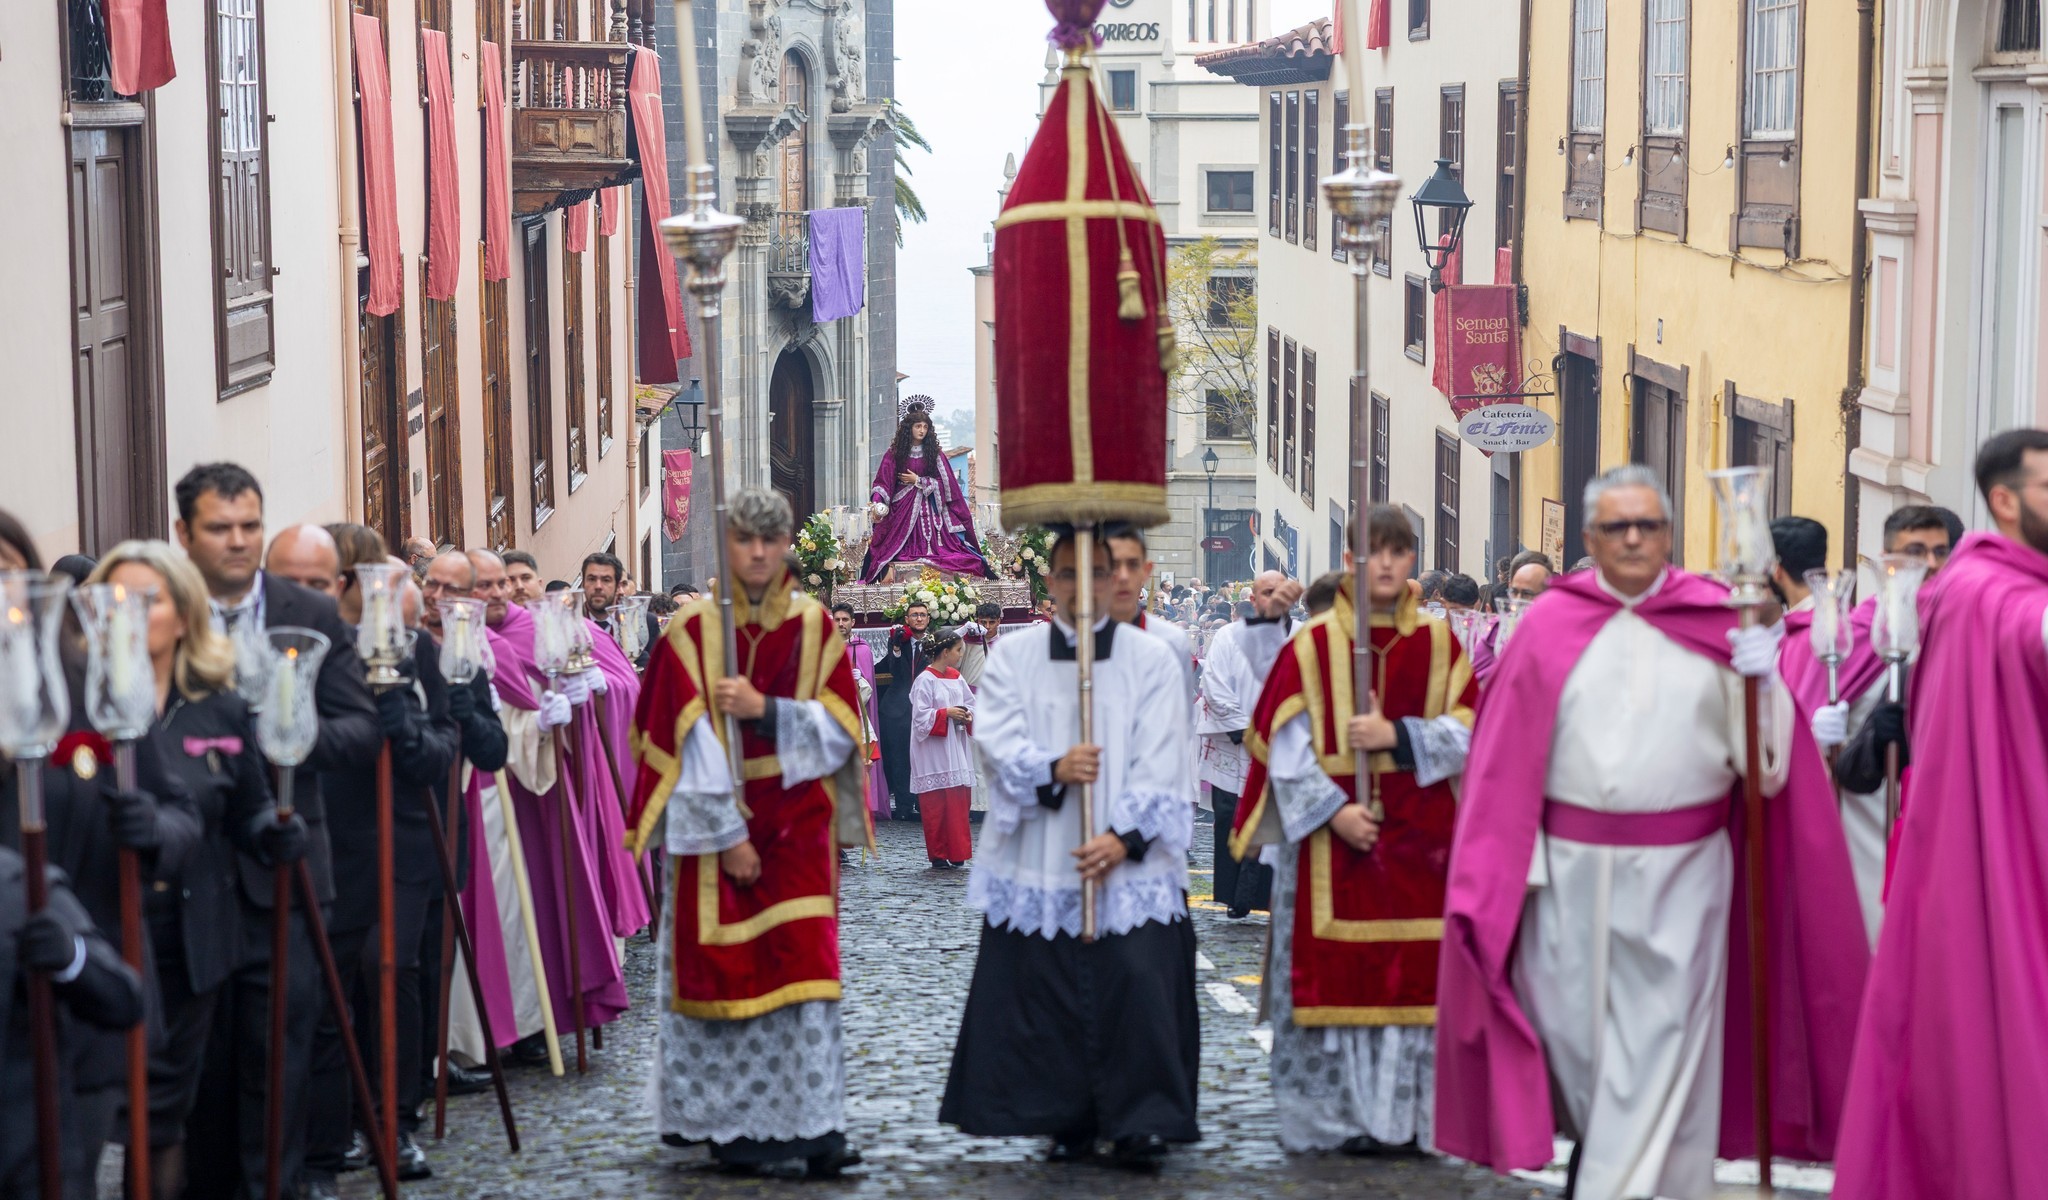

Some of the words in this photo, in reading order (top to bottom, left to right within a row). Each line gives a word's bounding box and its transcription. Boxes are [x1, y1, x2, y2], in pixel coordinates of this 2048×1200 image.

[1094, 22, 1160, 42] ORREOS
[1456, 316, 1510, 331] Seman
[1465, 329, 1509, 344] Santa
[1466, 421, 1491, 435] El
[667, 469, 692, 478] Semana
